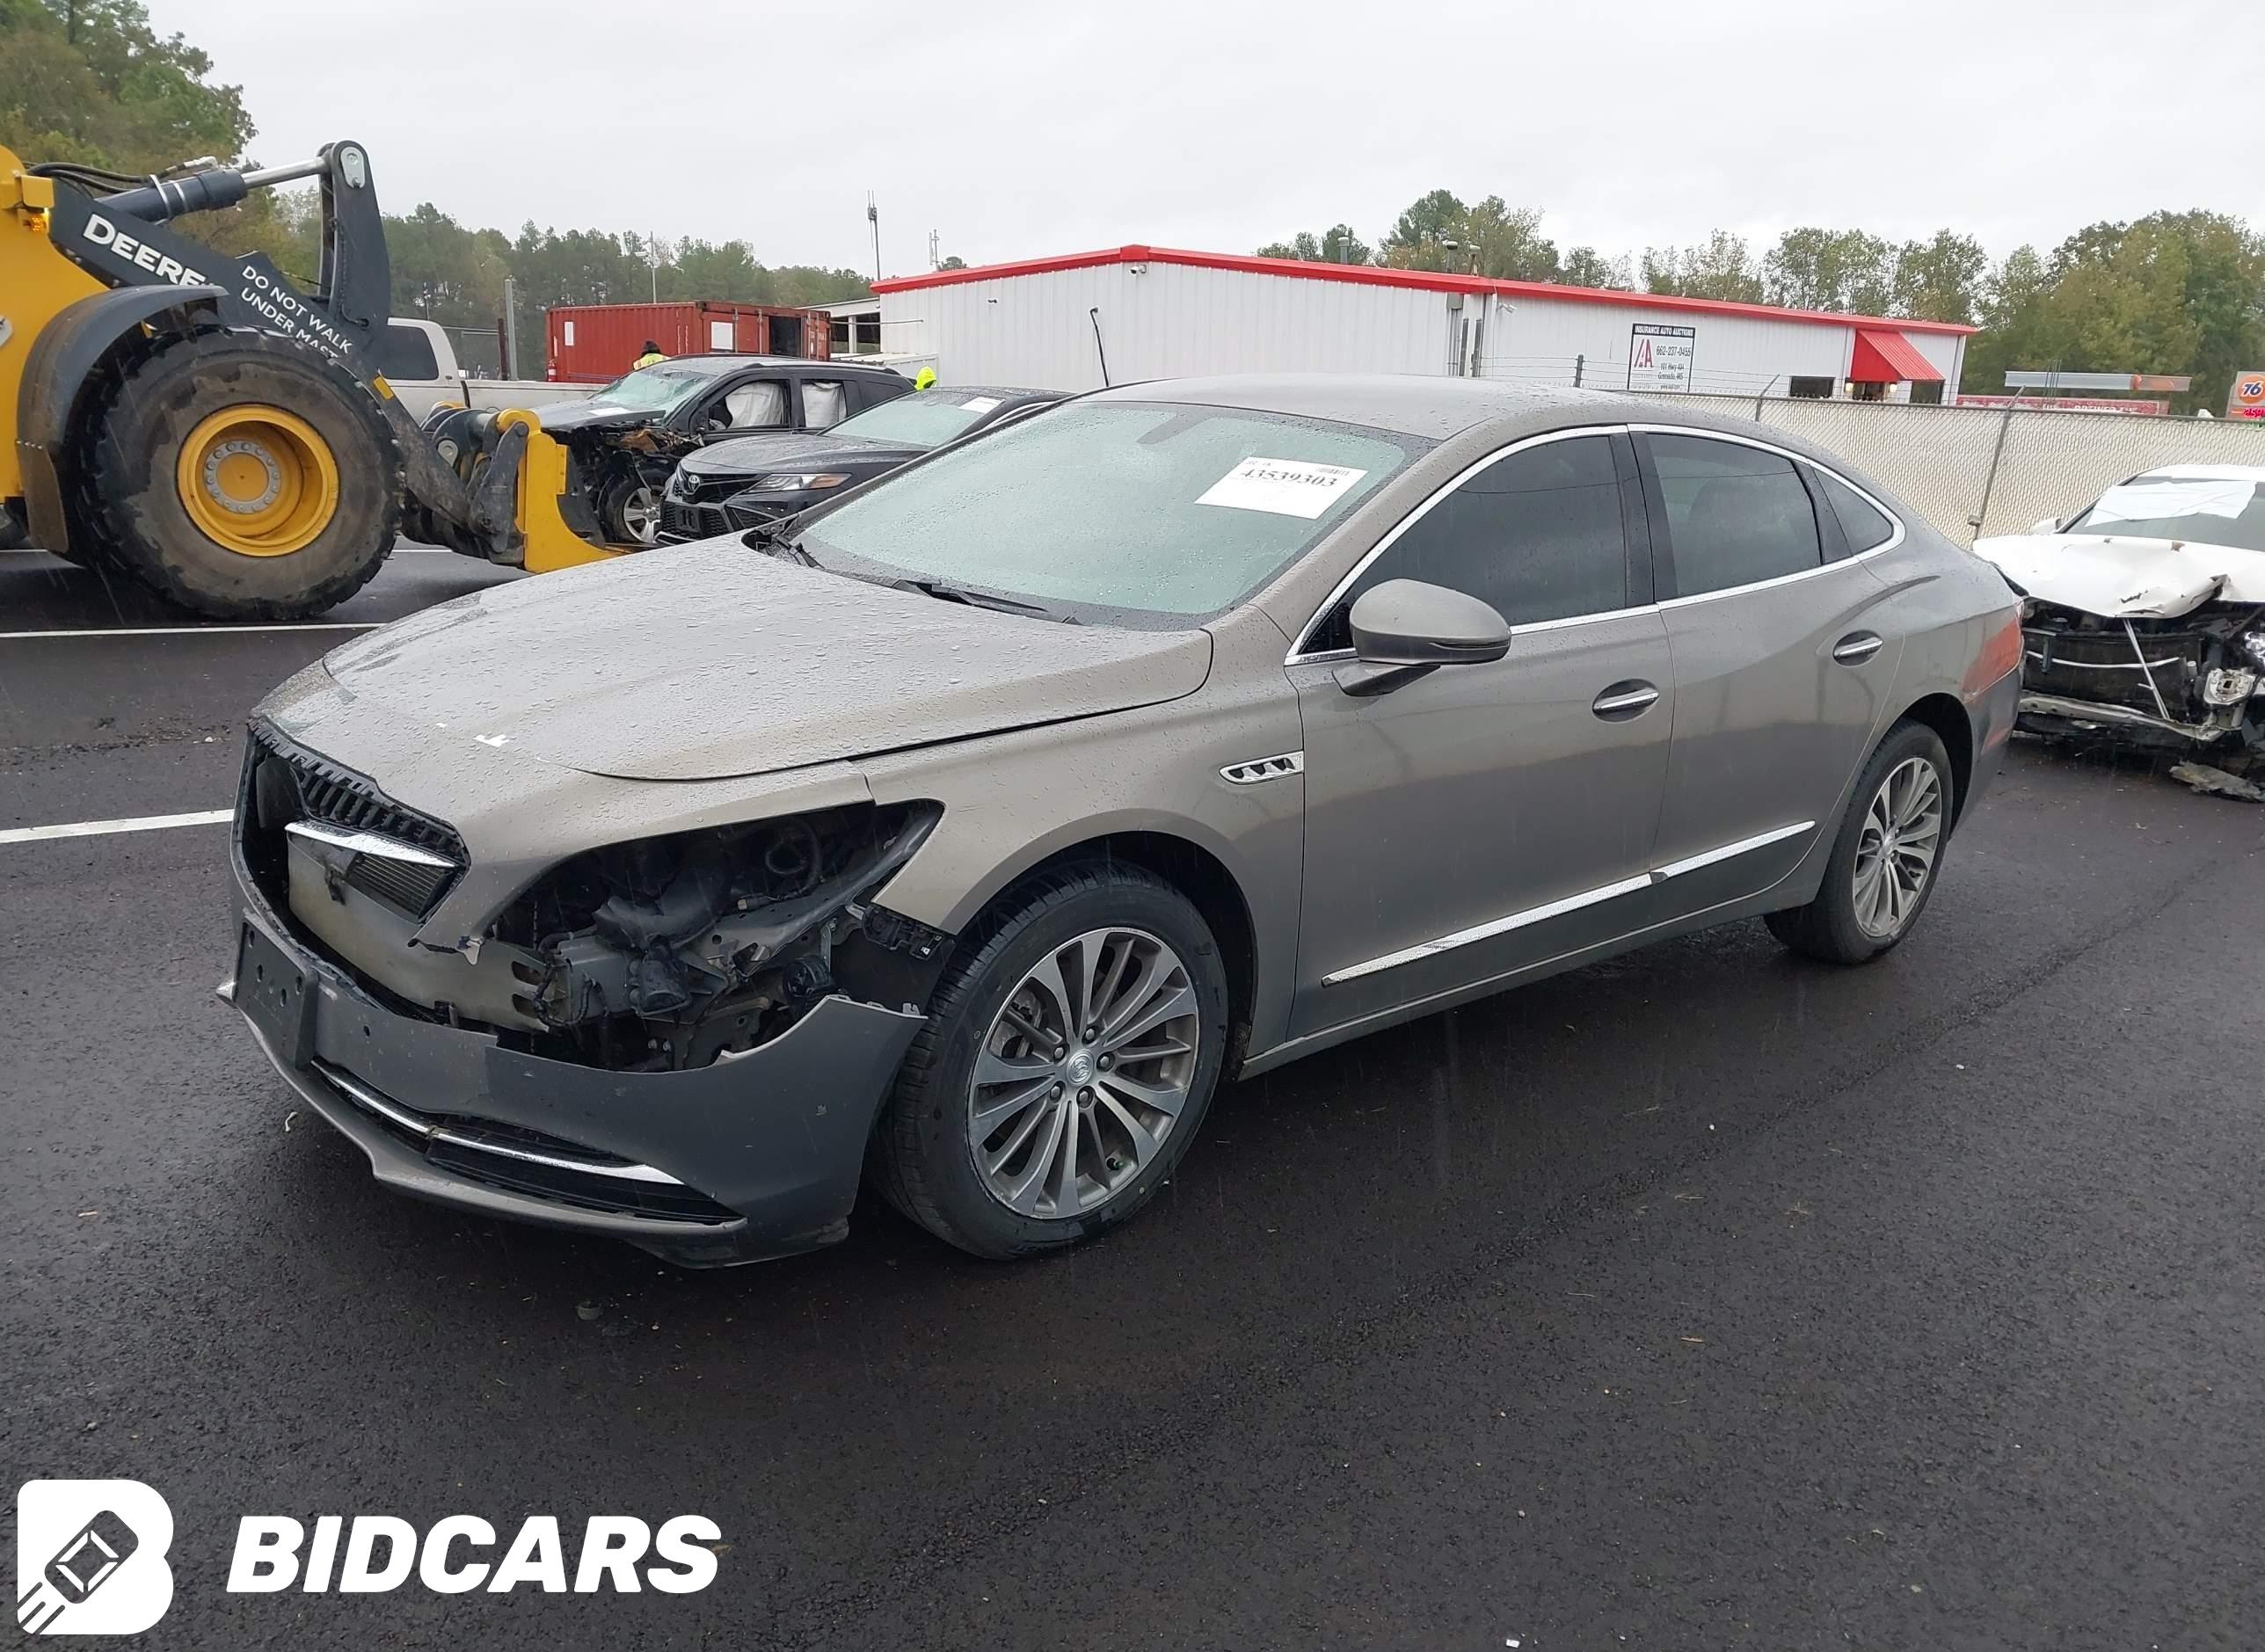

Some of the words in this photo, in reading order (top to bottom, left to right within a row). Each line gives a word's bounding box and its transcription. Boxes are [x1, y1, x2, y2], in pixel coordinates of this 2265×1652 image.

[82, 214, 207, 286] DEERE
[241, 287, 295, 333] UNDER
[242, 265, 269, 288] DO
[270, 287, 307, 317] NOT
[309, 311, 353, 354] WALK
[1635, 324, 1660, 334] INSURANCE
[1672, 328, 1693, 337] AUCTIONS
[2241, 381, 2264, 397] 76
[1241, 468, 1337, 487] 43539303
